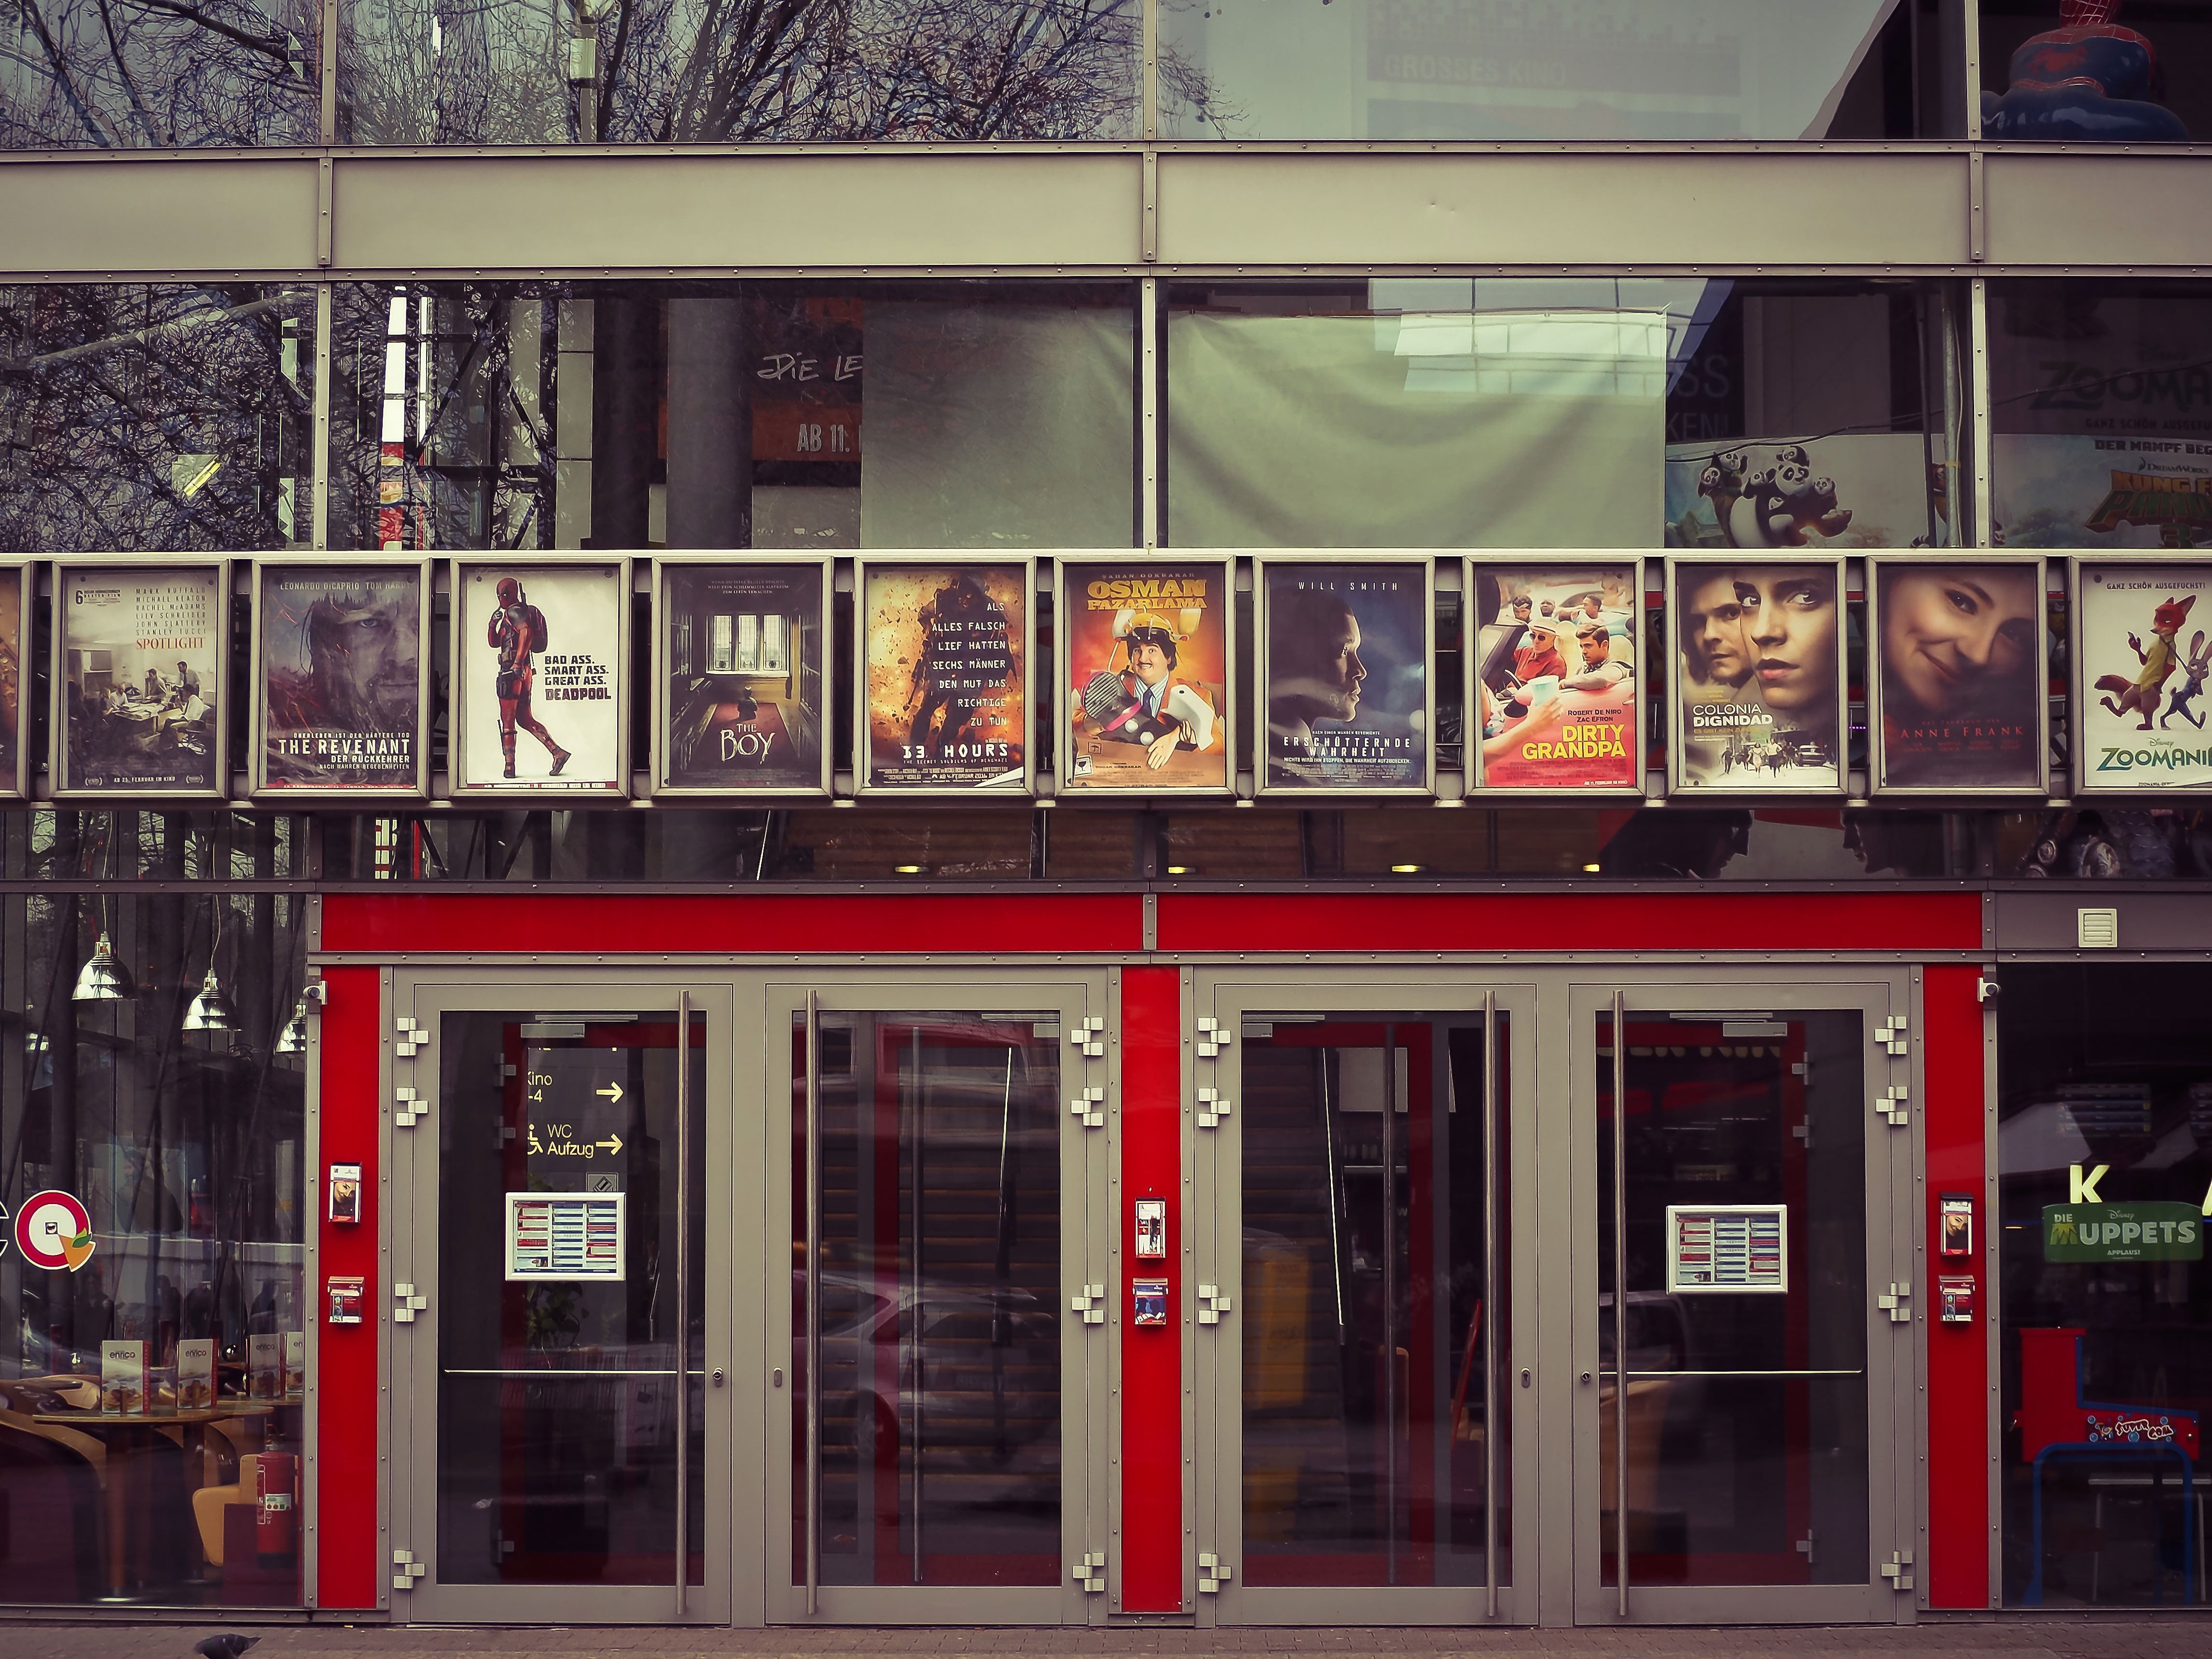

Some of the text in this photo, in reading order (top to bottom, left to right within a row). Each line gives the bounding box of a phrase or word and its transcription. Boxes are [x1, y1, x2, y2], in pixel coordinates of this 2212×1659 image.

[2086, 418, 2115, 429] GANZ
[2121, 416, 2157, 429] SCHÖN
[797, 424, 850, 452] AB 11.
[2095, 440, 2126, 451] DER
[2130, 441, 2182, 454] MAMPF
[2111, 470, 2191, 494] KUNG
[280, 582, 320, 590] LEONARDO
[1087, 580, 1206, 599] OSMAN
[1299, 582, 1397, 591] WILL SMITH
[2129, 581, 2152, 589] SCHÖN
[76, 590, 83, 604] 6
[987, 603, 1005, 611] ALS
[1087, 598, 1207, 610] PAZARLAMA
[932, 621, 1005, 631] ALLES FALSCH
[136, 637, 205, 650] SPOTLIGHT
[938, 641, 1006, 650] LIEF HATTEN
[545, 655, 594, 664] BAD ASS.
[932, 658, 1006, 670] SECHS MÄNNER
[545, 665, 609, 675] SMART ASS.
[545, 676, 607, 685] GREAT ASS.
[939, 679, 1006, 689] DEN MUT DAS
[545, 687, 611, 700] DEADPOOL
[958, 698, 1007, 707] RICHTIGE
[1693, 703, 1762, 715] COLONIA
[970, 717, 1007, 726] ZU TUN
[1693, 714, 1773, 727] DIGNIDAD
[736, 724, 757, 733] THE
[1562, 724, 1625, 742] DIRTY
[1901, 726, 2023, 738] ANNE FRANK
[278, 739, 410, 754] THE REVENANT
[720, 729, 775, 764] BOY
[1284, 736, 1410, 748] ERSCHÜTTERNDE
[944, 744, 1008, 758] HOURS
[1309, 747, 1384, 757] WAHRHEIT
[1522, 741, 1627, 760] GRANDPA
[352, 754, 410, 763] RÜCKKEHRER
[547, 1123, 572, 1138] WC
[547, 1141, 594, 1159] Aufzug
[2054, 1213, 2073, 1222] DIE
[2050, 1221, 2196, 1245] MUPPETS
[256, 1342, 275, 1351] enrico
[109, 1351, 136, 1359] enrico
[185, 1349, 207, 1357] enrico
